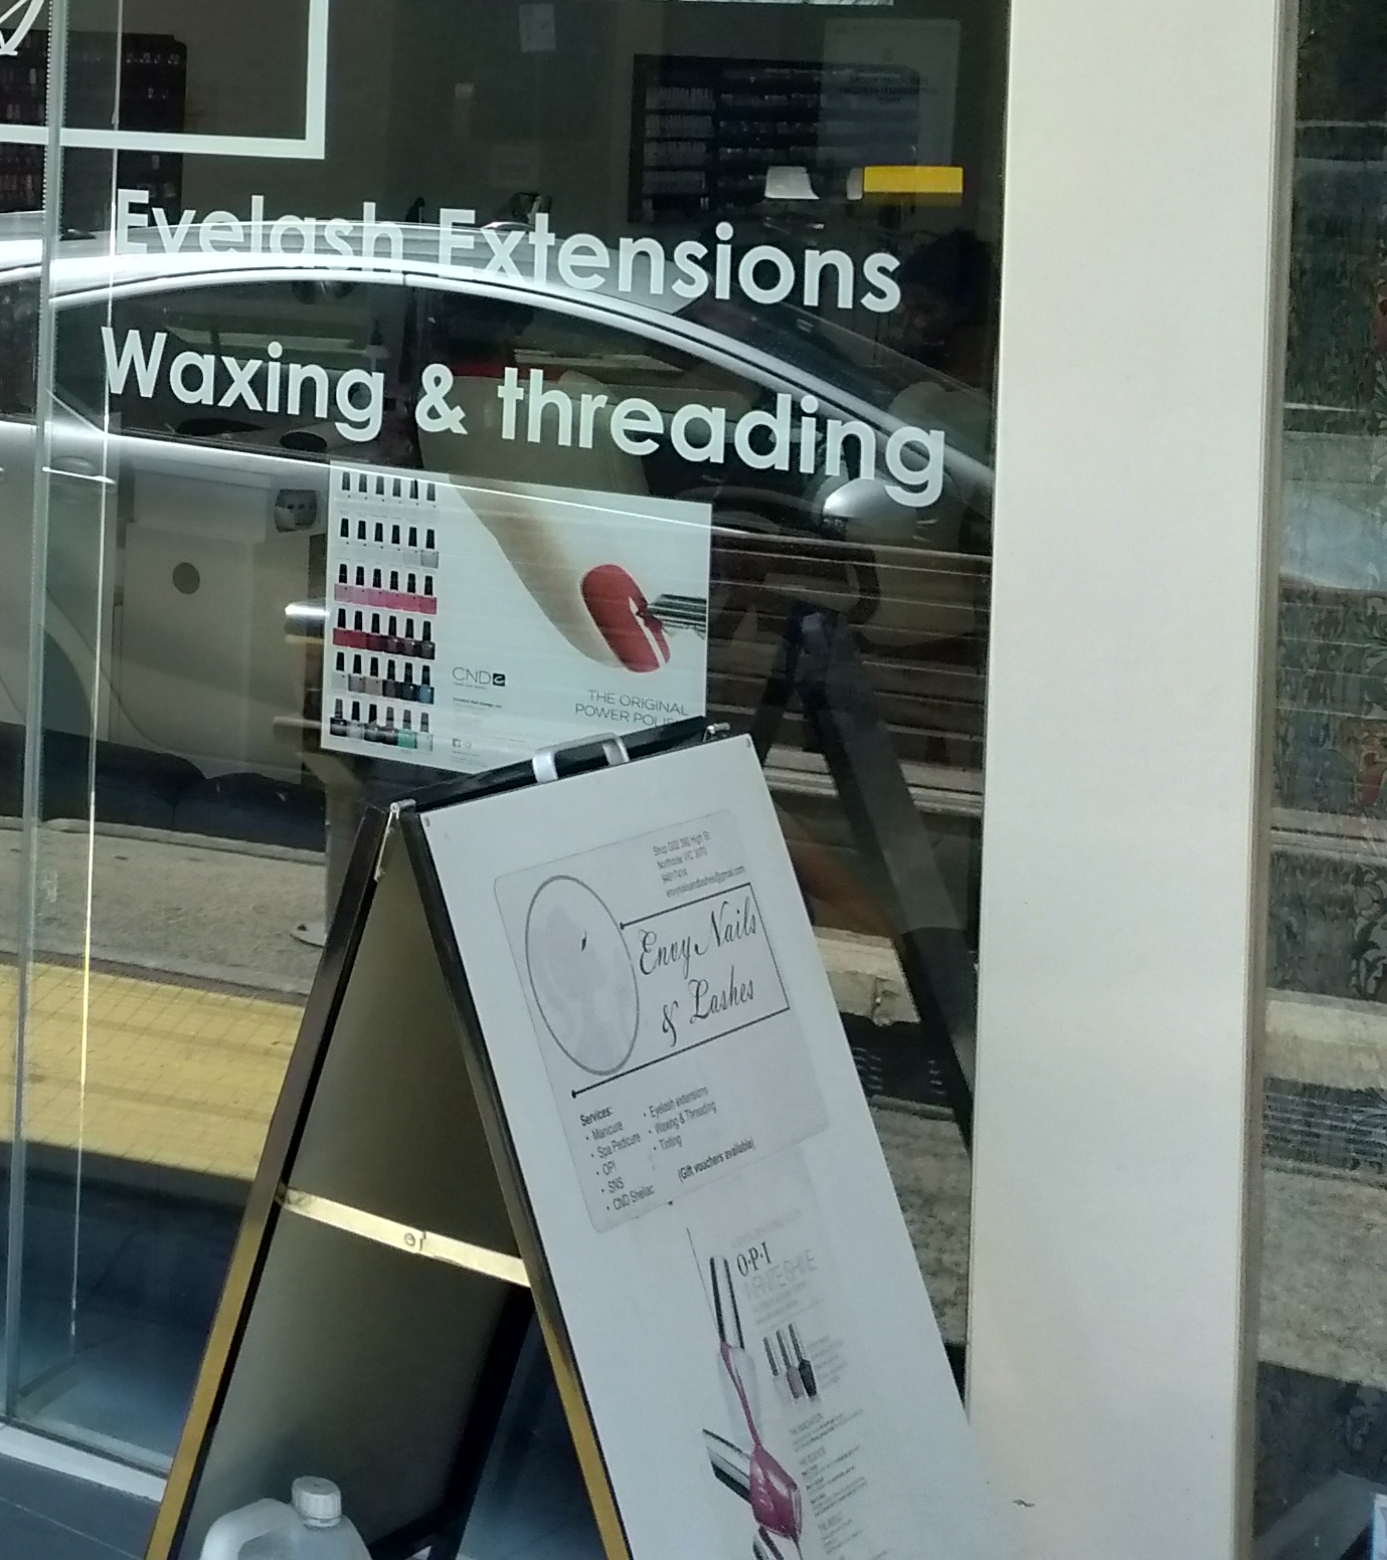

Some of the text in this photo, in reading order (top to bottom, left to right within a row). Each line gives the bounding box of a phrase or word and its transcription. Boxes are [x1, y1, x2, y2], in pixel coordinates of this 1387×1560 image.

[115, 188, 903, 315] Eyelash Extensions
[102, 326, 946, 510] Waxing & threading
[452, 666, 491, 685] CND
[575, 703, 629, 722] POWER
[588, 689, 689, 717] THE ORIGINAL
[639, 896, 757, 980] Envy Nails
[662, 965, 754, 1048] & Lashes
[649, 1086, 709, 1119] Eyelash extensions
[580, 1106, 613, 1127] Services:
[655, 1116, 680, 1134] Waxing
[685, 1101, 717, 1120] Threading
[592, 1120, 623, 1141] Manicure
[597, 1132, 641, 1160] Spa Pedicure
[602, 1159, 618, 1177] OPI
[694, 1152, 725, 1174] vouchers
[607, 1176, 625, 1194] SNS
[613, 1185, 655, 1211] CND Shellac
